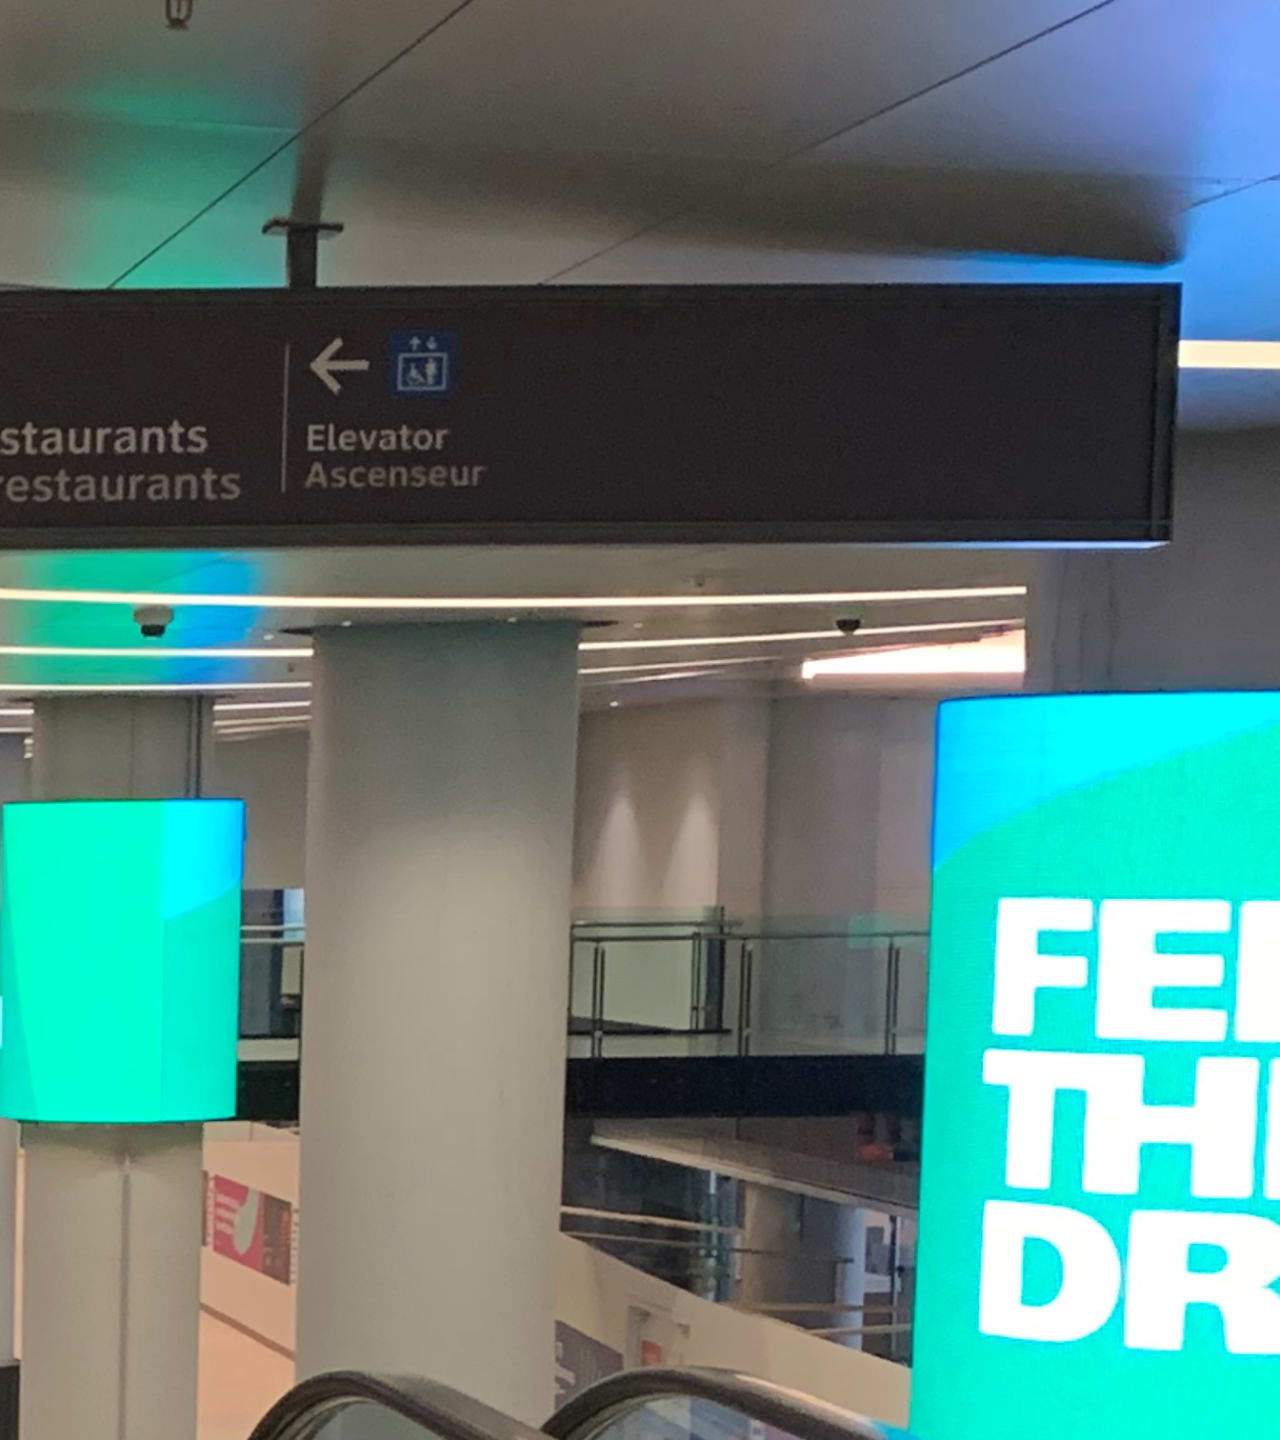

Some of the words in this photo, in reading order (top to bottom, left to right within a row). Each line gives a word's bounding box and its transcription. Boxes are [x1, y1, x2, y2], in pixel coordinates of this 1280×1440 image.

[306, 423, 450, 452] Elevator
[306, 460, 484, 489] Ascenseur
[982, 1049, 1280, 1202] TH
